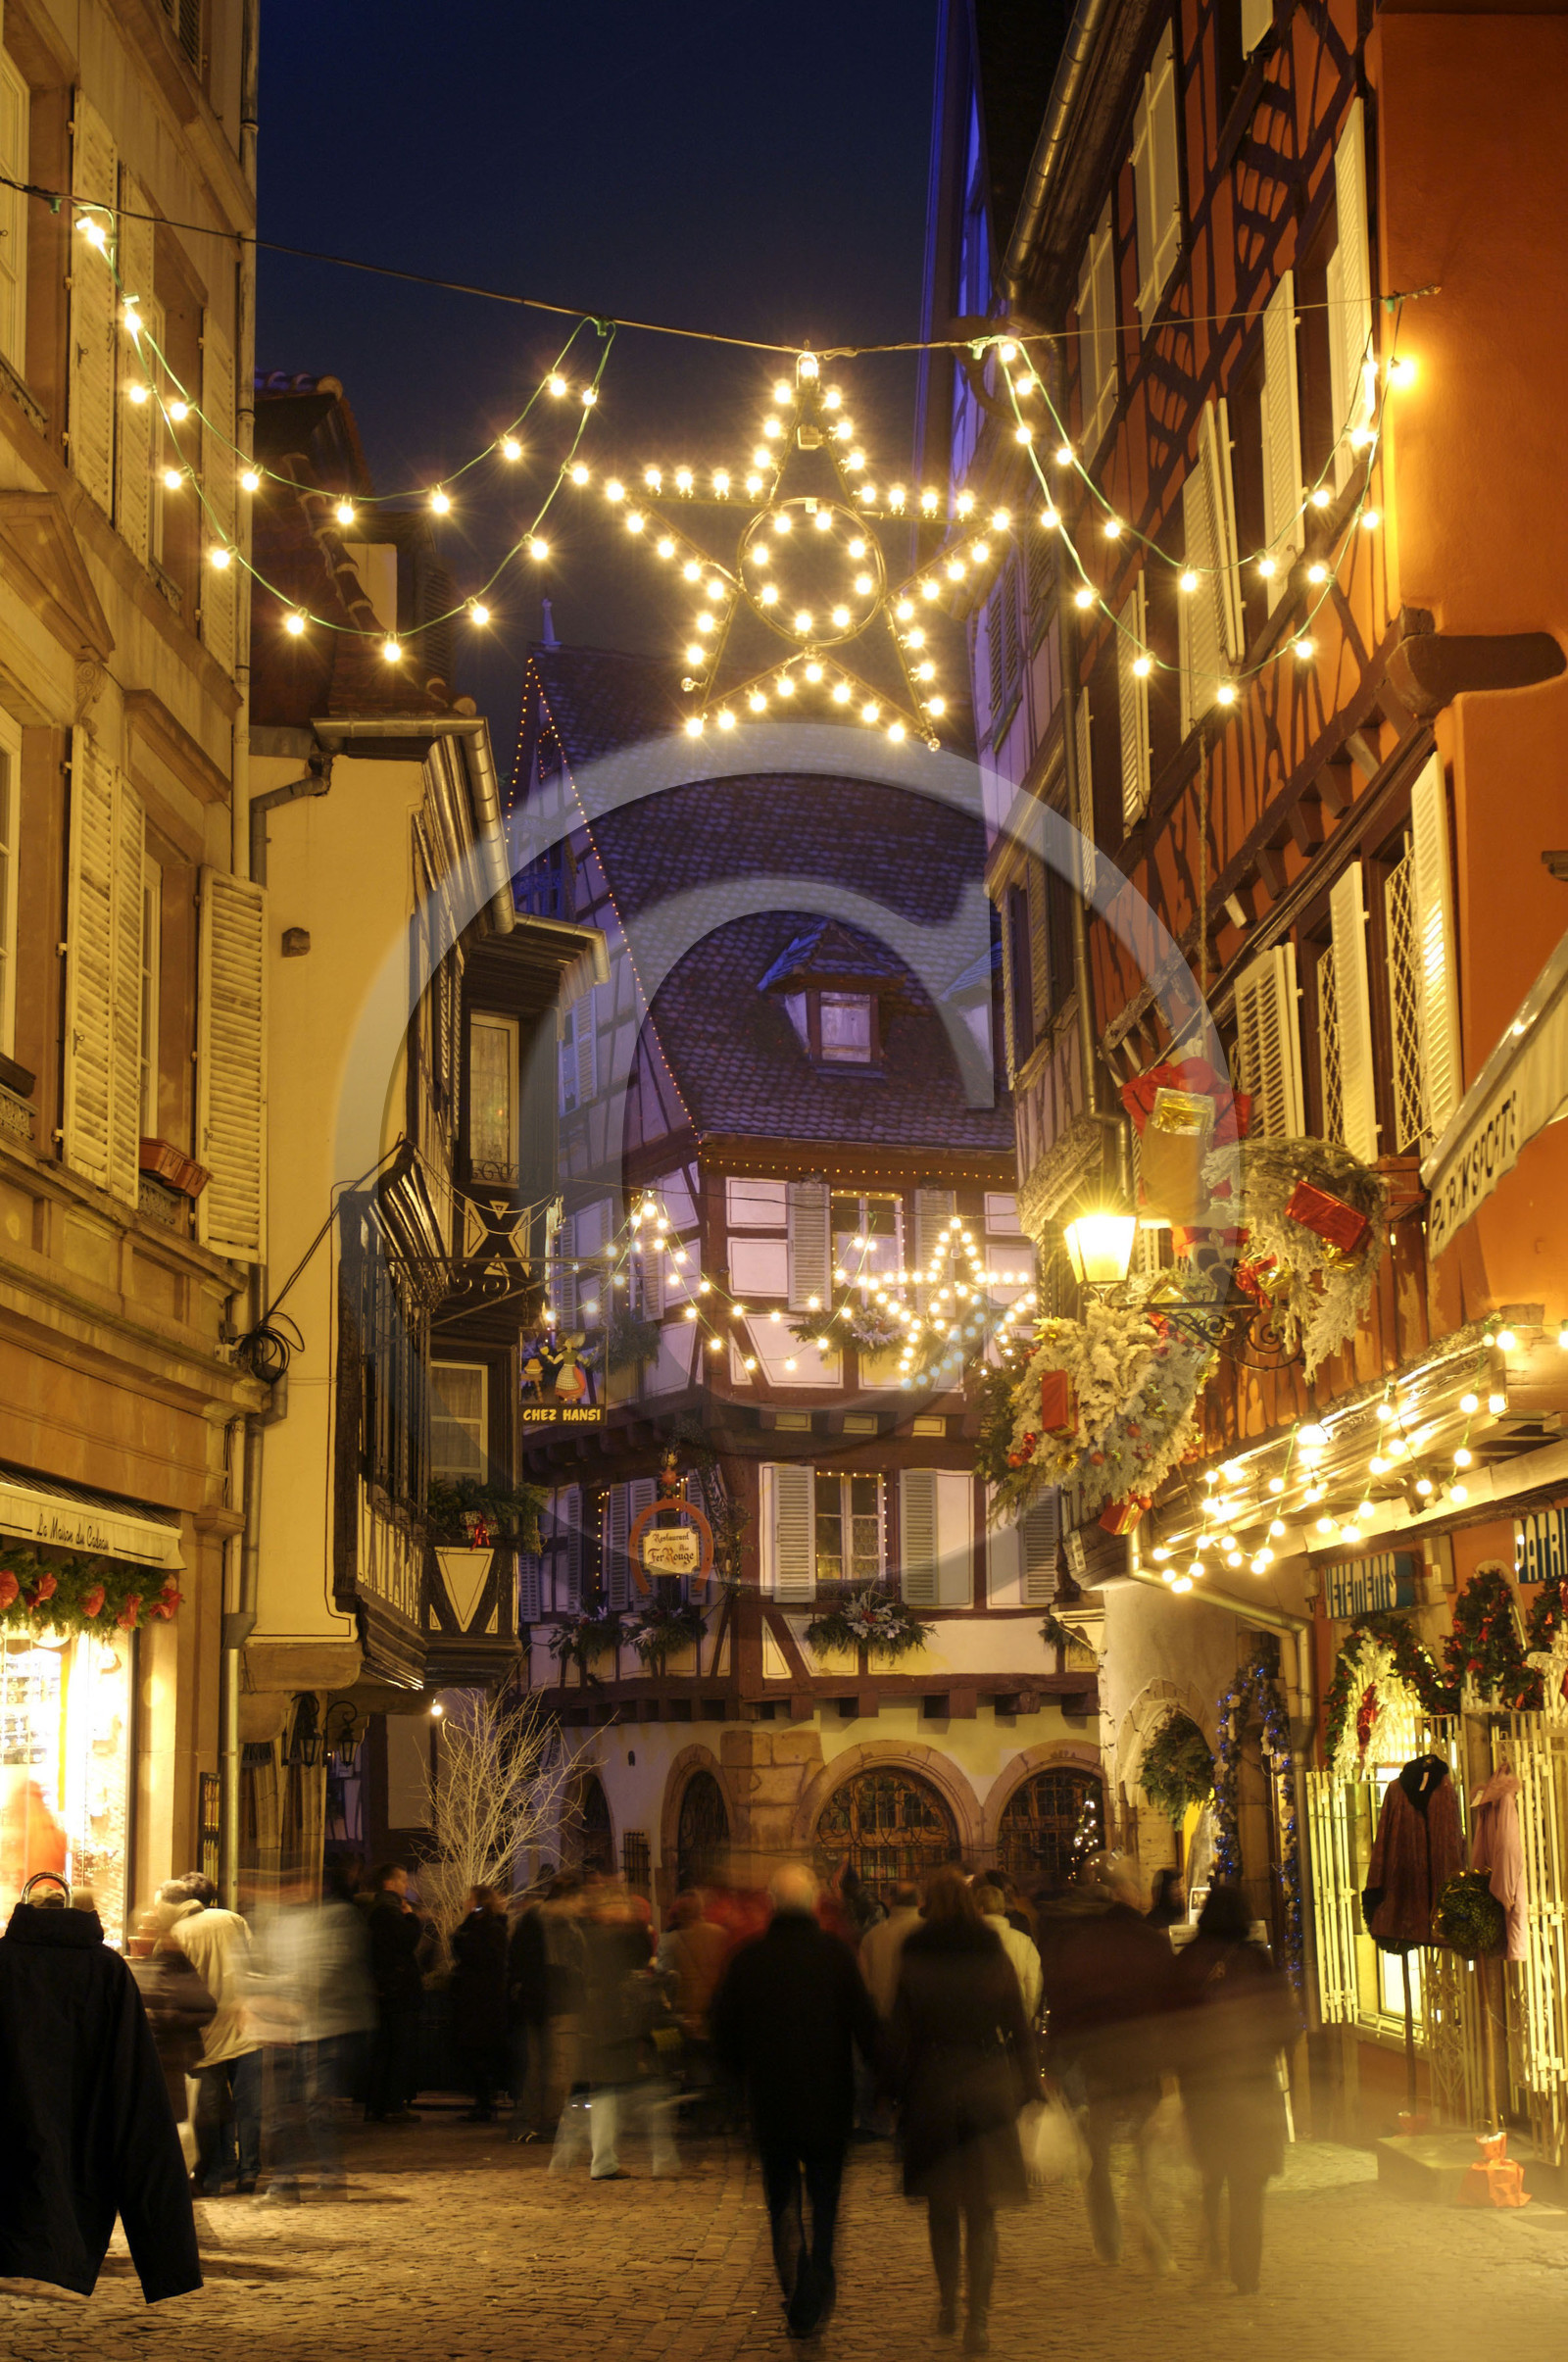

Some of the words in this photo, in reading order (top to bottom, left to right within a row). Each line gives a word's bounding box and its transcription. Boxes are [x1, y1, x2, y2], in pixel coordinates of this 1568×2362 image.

[522, 1408, 557, 1421] CHEZ
[563, 1408, 601, 1421] HANSI
[37, 1512, 48, 1537] La
[49, 1516, 74, 1543] Maison
[75, 1522, 85, 1545] du
[652, 1532, 690, 1544] Restaurant
[1513, 1506, 1568, 1584] PATRI
[648, 1548, 664, 1565] Fer
[662, 1547, 695, 1565] Rouge
